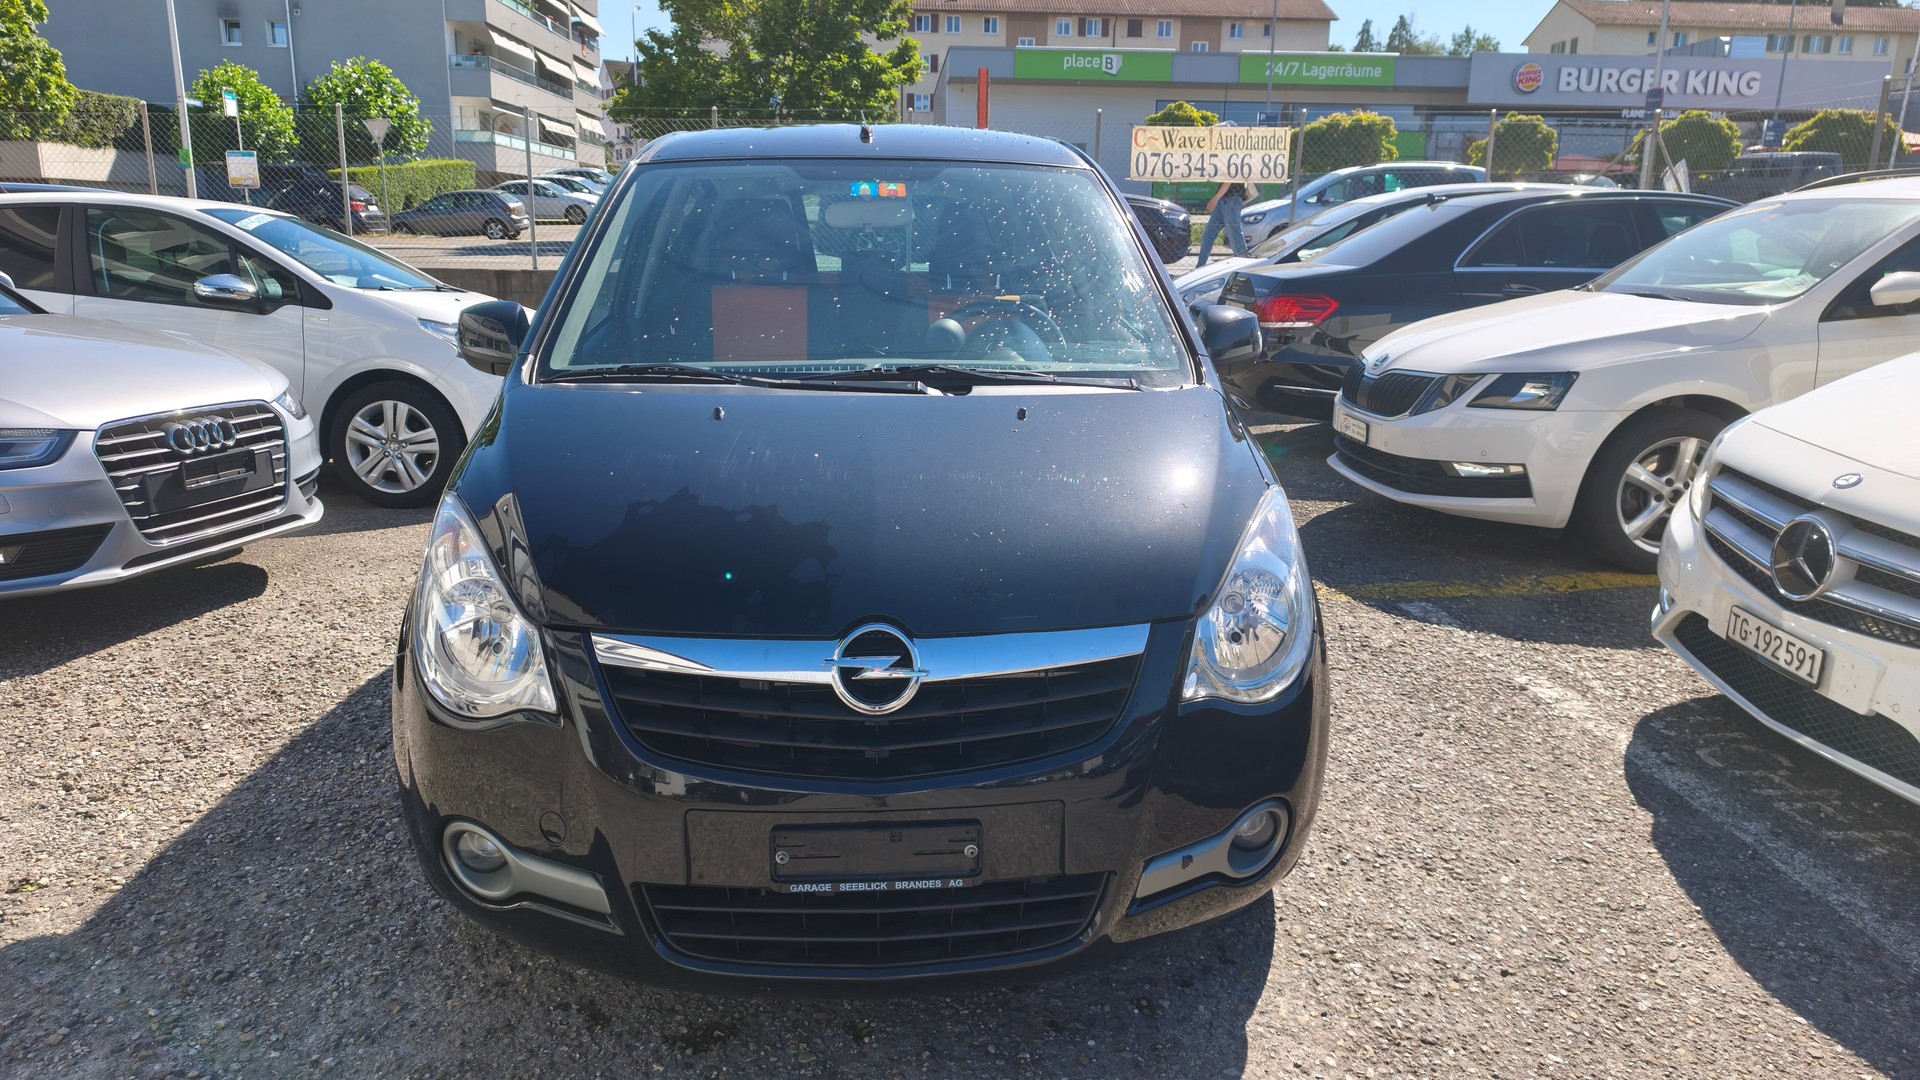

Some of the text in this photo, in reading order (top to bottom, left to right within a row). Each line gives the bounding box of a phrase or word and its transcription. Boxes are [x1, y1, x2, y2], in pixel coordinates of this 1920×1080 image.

[1063, 53, 1100, 70] place
[1265, 61, 1383, 80] 24/7 Lagerräume
[1517, 74, 1542, 85] KING
[1685, 70, 1762, 96] KING
[1214, 129, 1288, 151] Autohandel
[1135, 151, 1286, 179] 076-345 66 86
[789, 878, 963, 892] GARAGE SEEBLICK BRANDES AG
